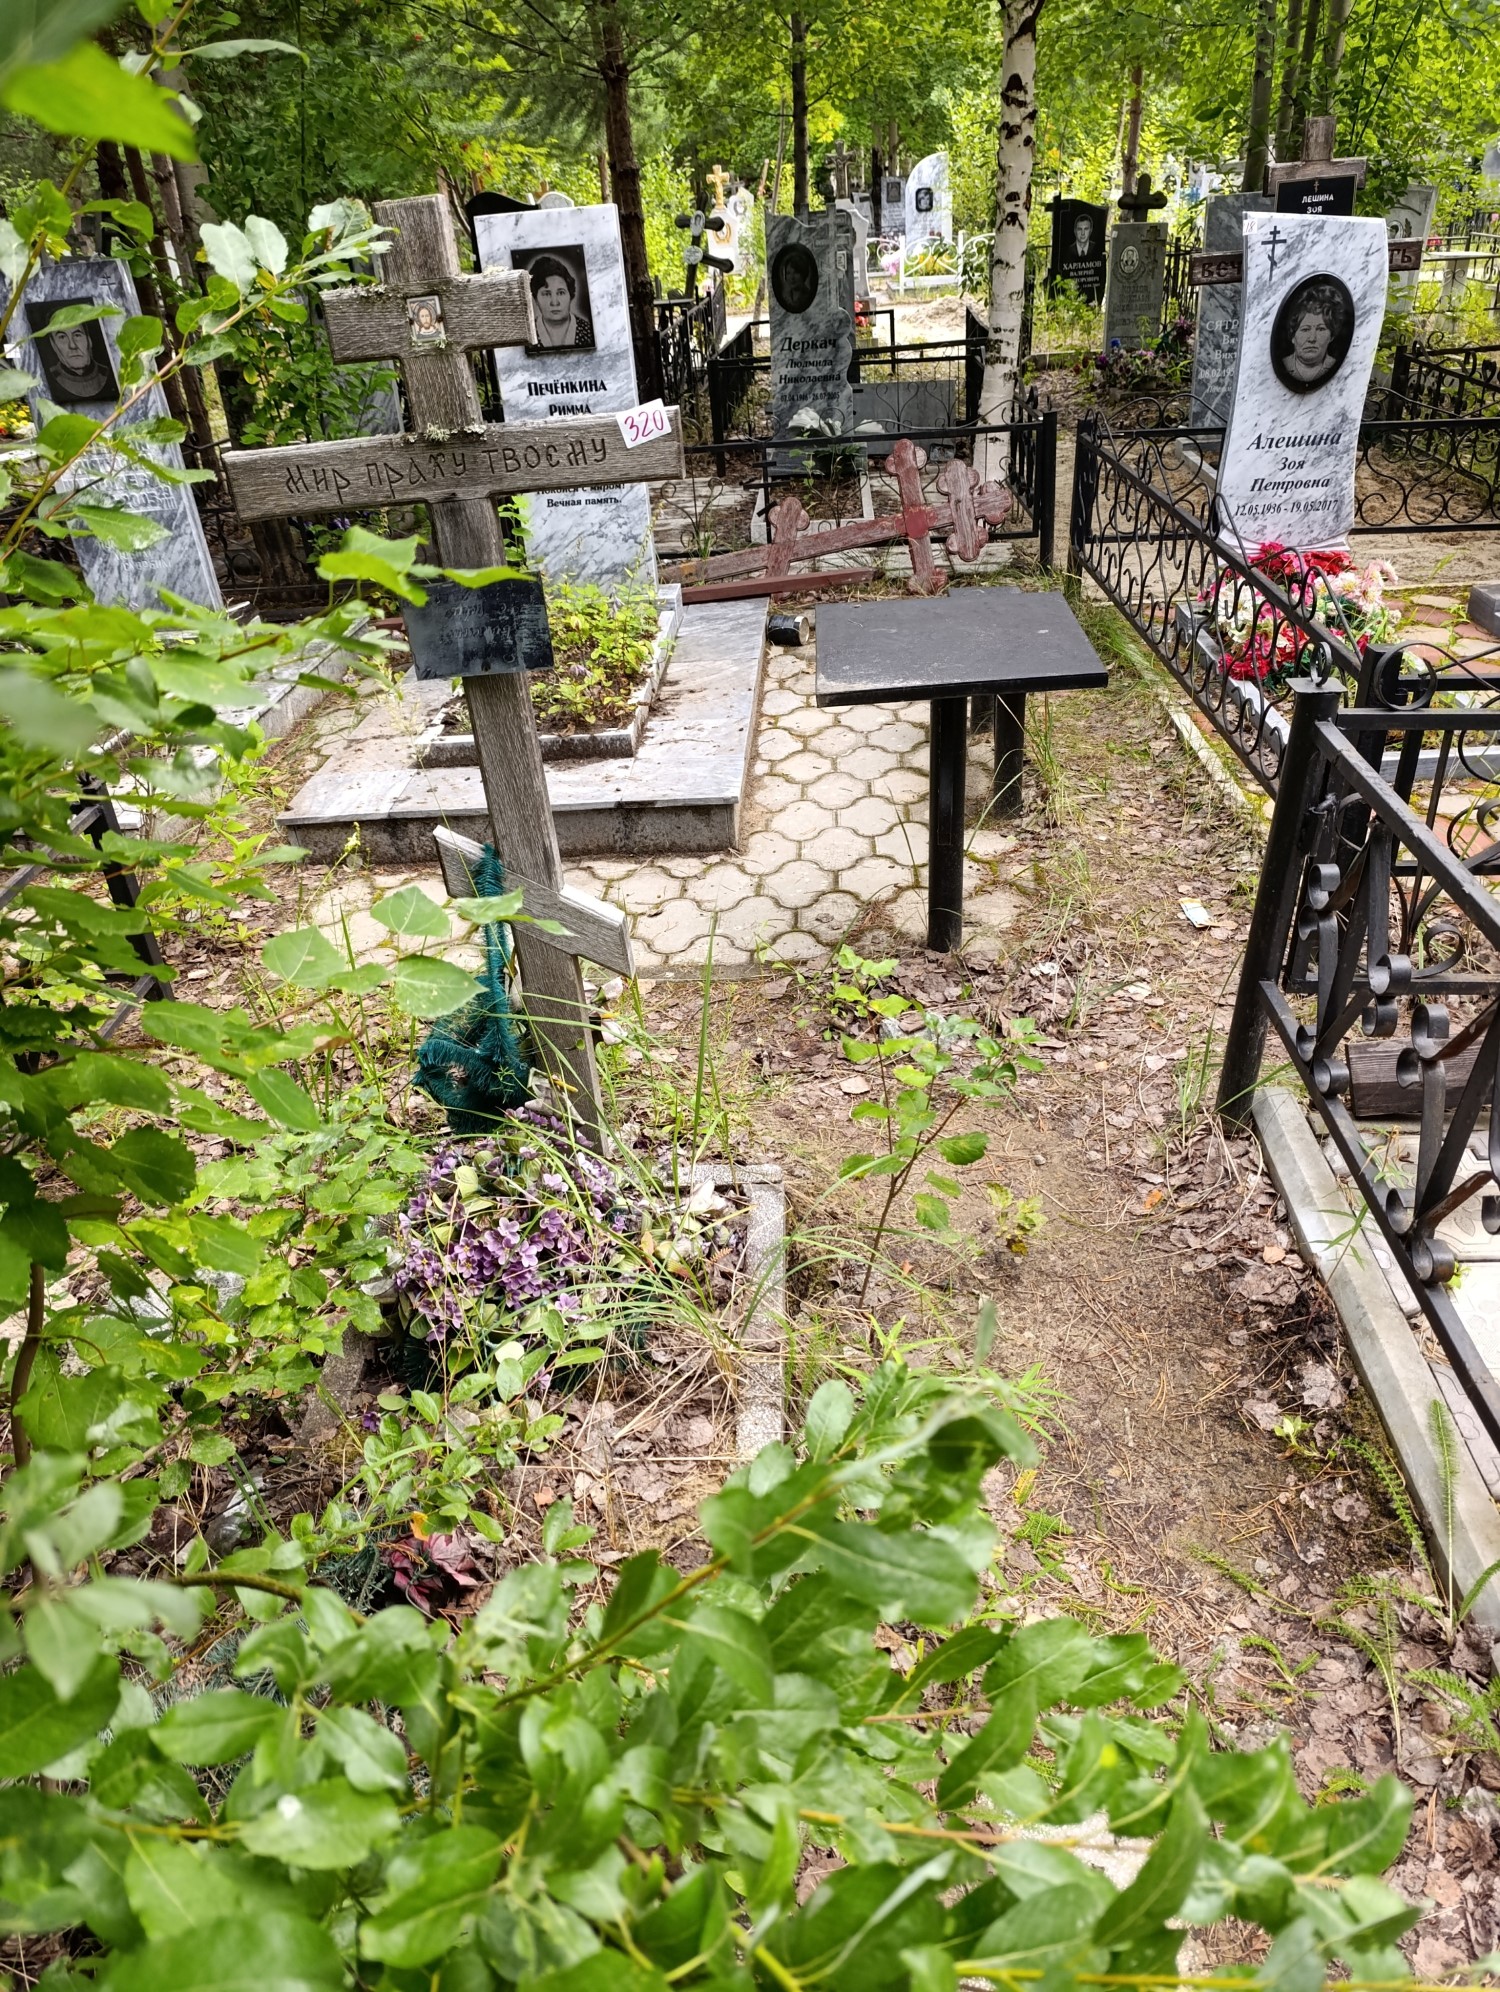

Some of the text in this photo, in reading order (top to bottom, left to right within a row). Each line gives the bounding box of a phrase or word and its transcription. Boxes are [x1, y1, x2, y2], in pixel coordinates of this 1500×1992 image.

[1206, 320, 1240, 331] СЯТР
[780, 337, 838, 353] Деркач
[785, 359, 833, 368] Людмила
[779, 374, 841, 385] Николаевна
[624, 409, 664, 442] 320
[1246, 433, 1342, 450] Алешина
[1278, 457, 1306, 471] Зоя
[1250, 478, 1331, 493] Петровна
[547, 499, 581, 508] Вечная
[1234, 503, 1282, 516] 12.05.1936
[1290, 500, 1339, 513] 19.05.2017
